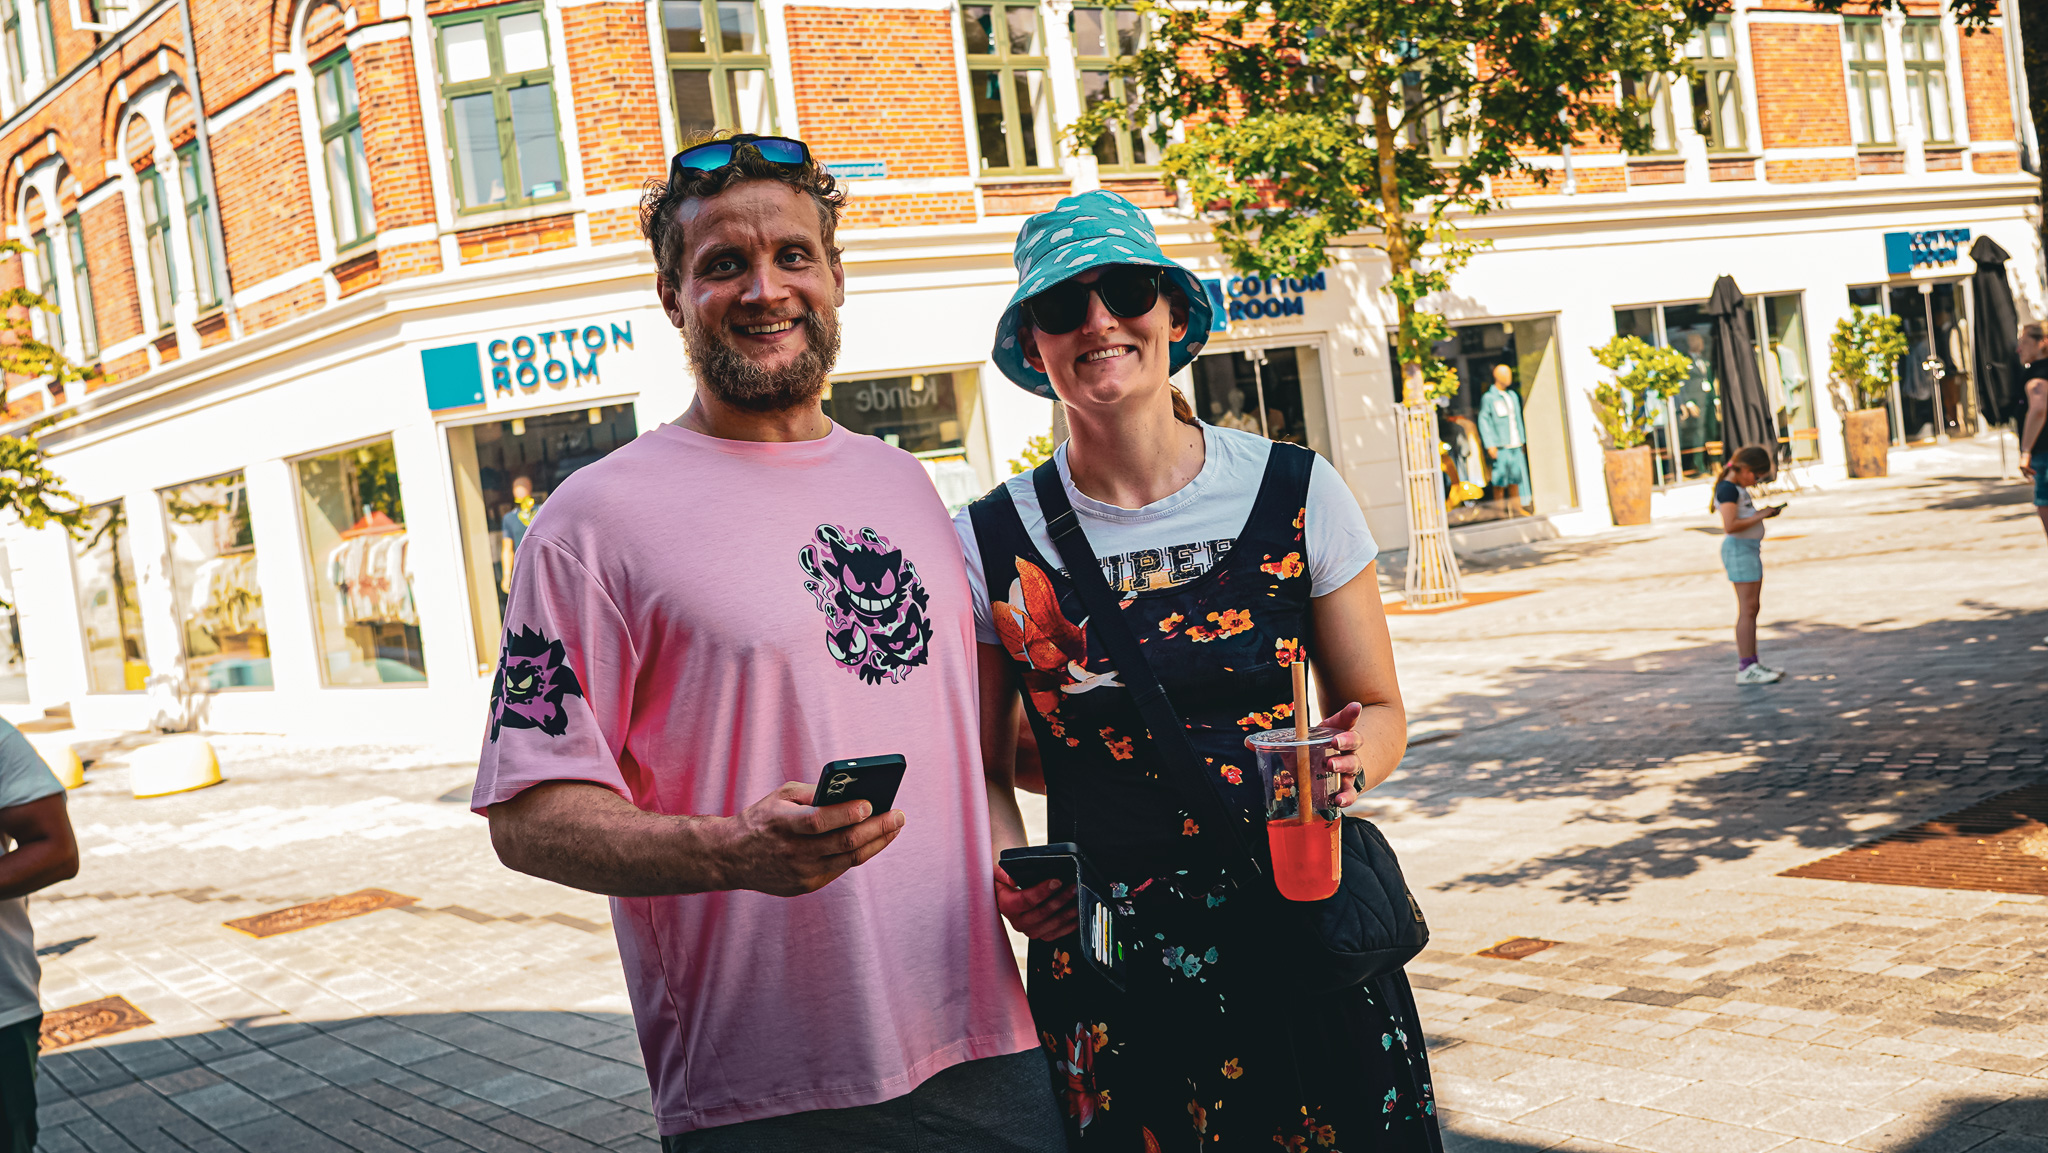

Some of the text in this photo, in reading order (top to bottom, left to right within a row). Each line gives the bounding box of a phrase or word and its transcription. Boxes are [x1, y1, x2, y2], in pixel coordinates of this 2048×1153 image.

[1230, 296, 1304, 321] ROOM
[488, 320, 633, 365] COTTON
[491, 352, 600, 394] ROOM
